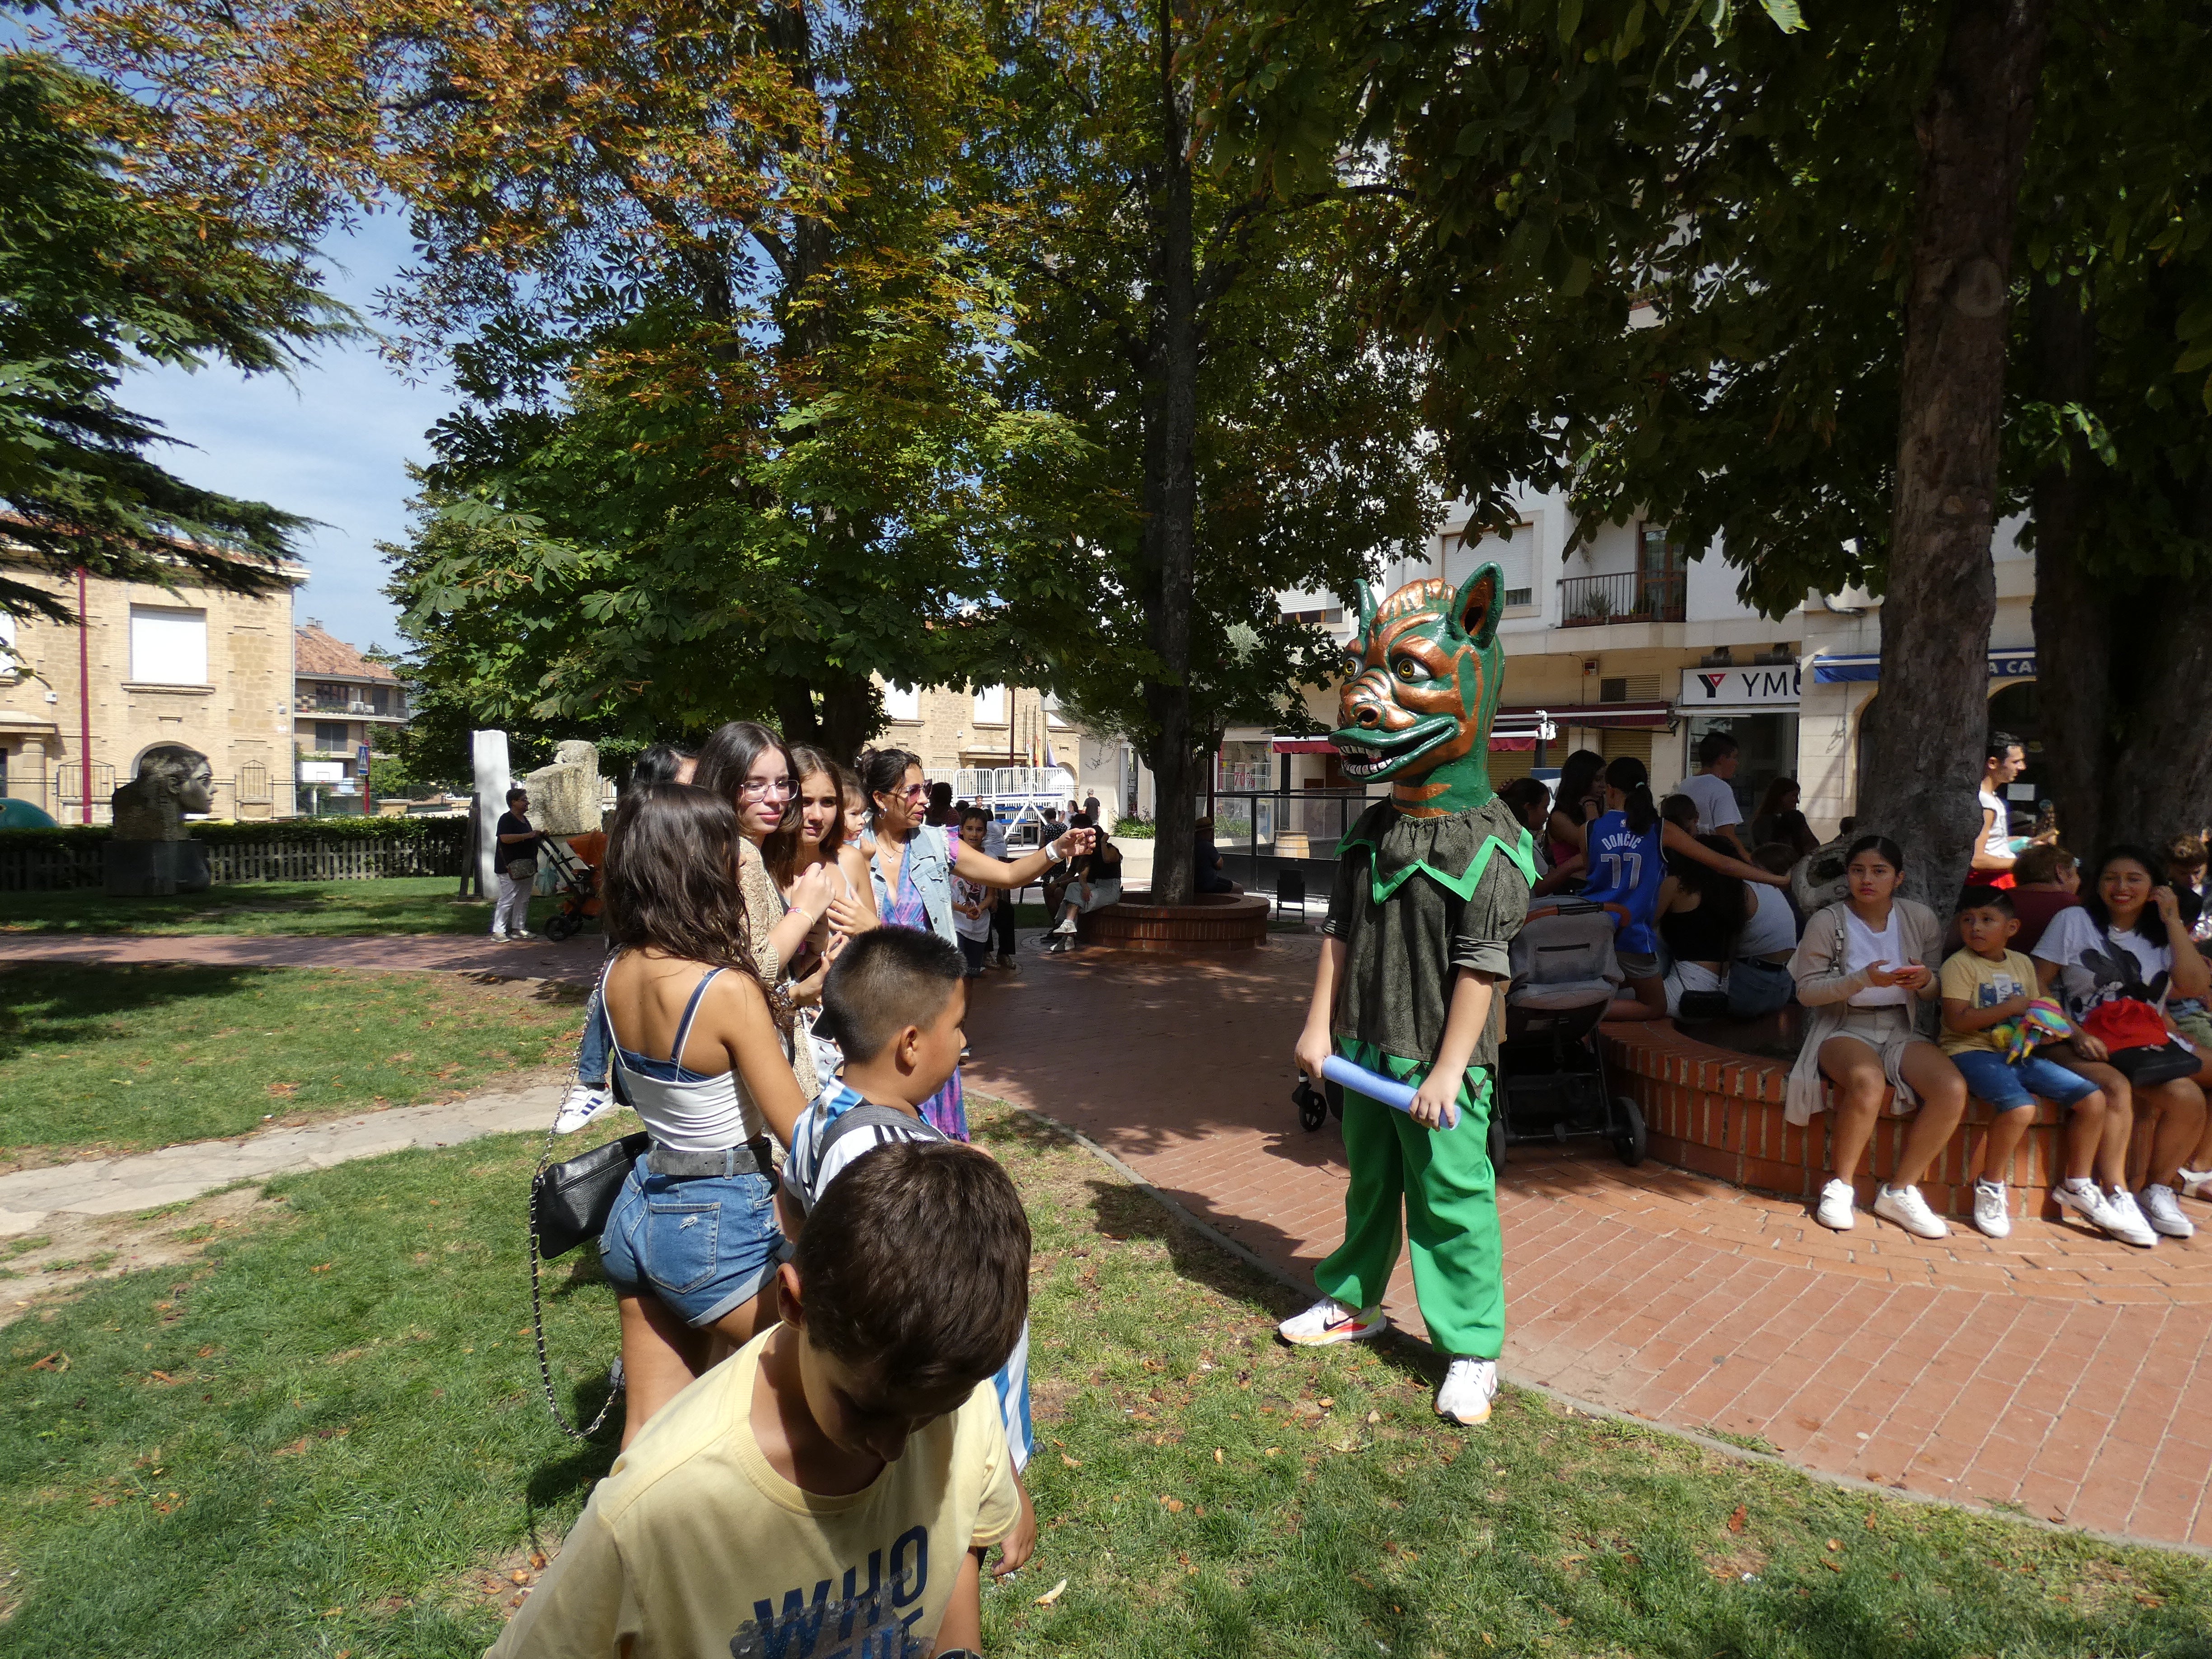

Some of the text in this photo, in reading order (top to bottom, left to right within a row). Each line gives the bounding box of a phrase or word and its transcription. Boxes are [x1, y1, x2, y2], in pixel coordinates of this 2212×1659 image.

[1601, 830, 1644, 850] DONČIĆ
[1600, 853, 1642, 890] 77
[753, 1525, 928, 1659] WHO
